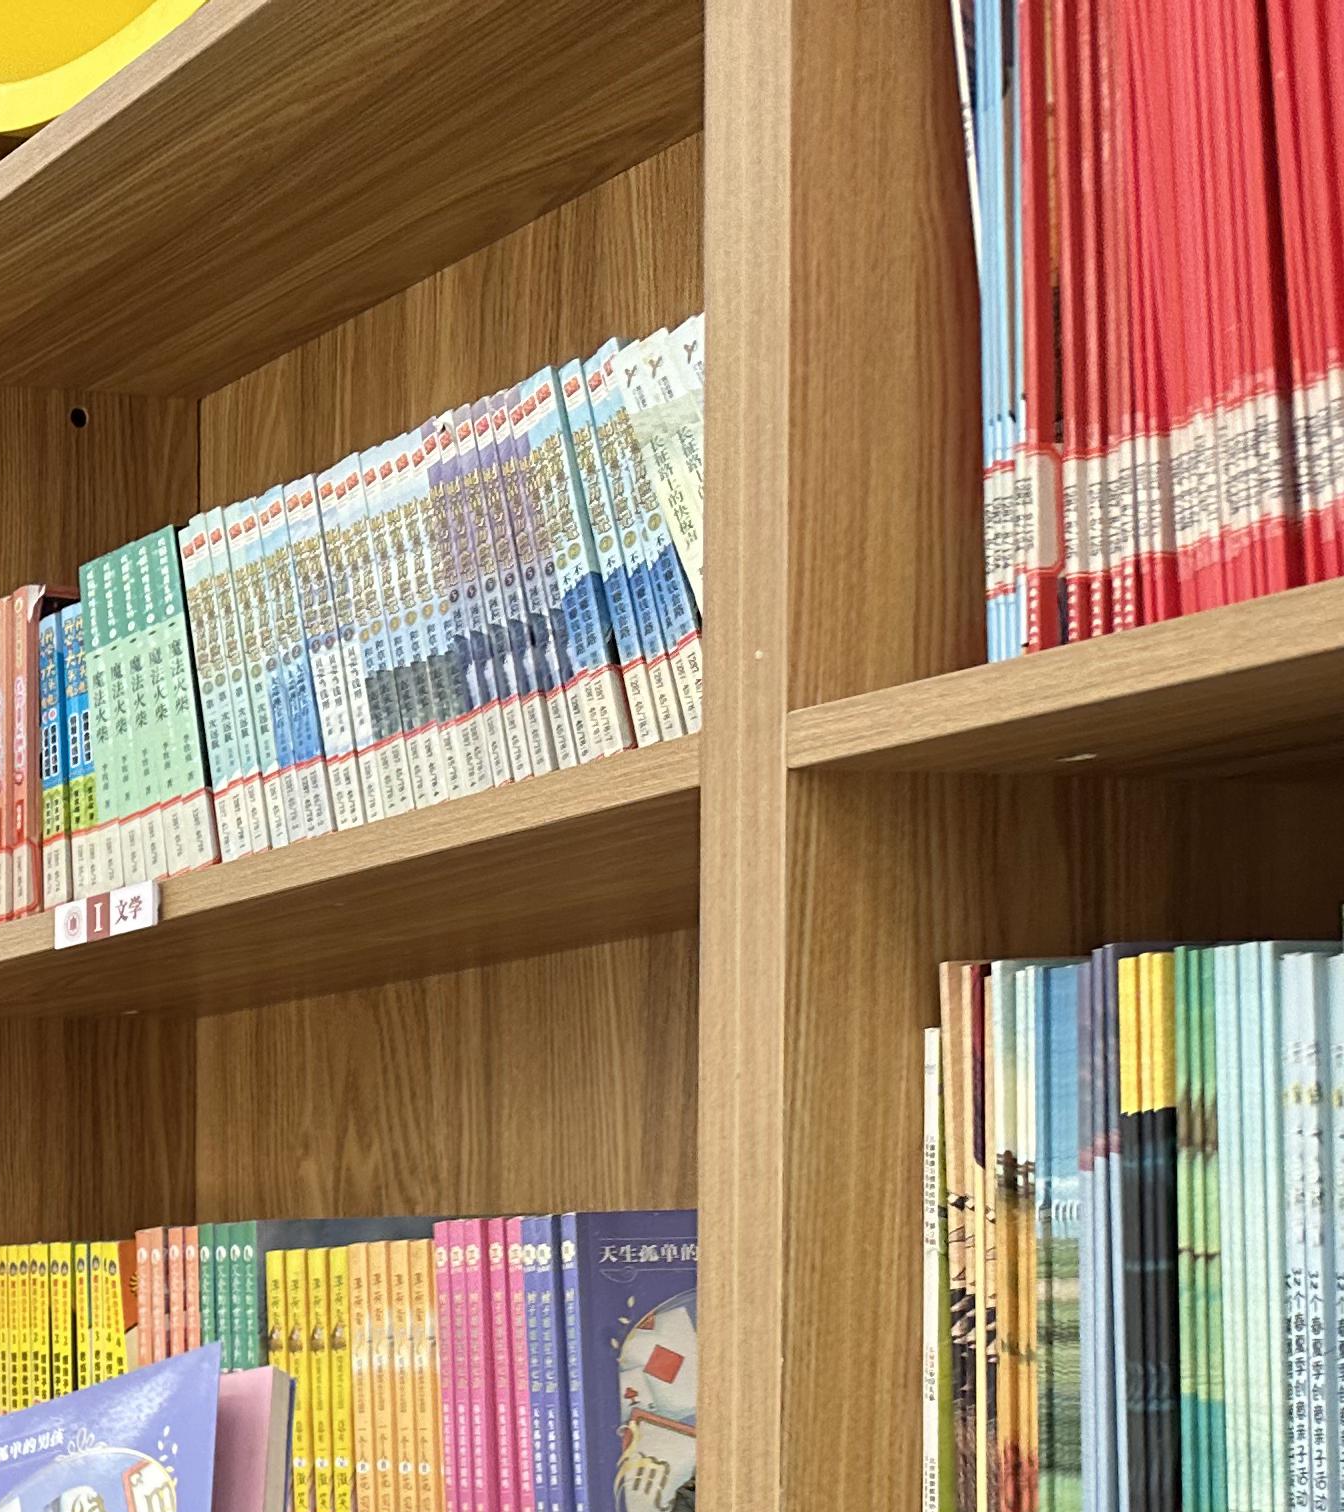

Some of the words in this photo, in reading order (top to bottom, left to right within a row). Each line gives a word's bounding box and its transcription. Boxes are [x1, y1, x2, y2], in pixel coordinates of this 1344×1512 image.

[92, 669, 110, 744] 魔法火柴
[110, 660, 128, 736] 魔法火柴
[129, 654, 148, 729] 魔法火柴
[148, 646, 169, 722] 魔法火柴
[167, 638, 190, 715] 魔法火柴
[93, 902, 104, 933] I
[115, 895, 143, 925] 文学
